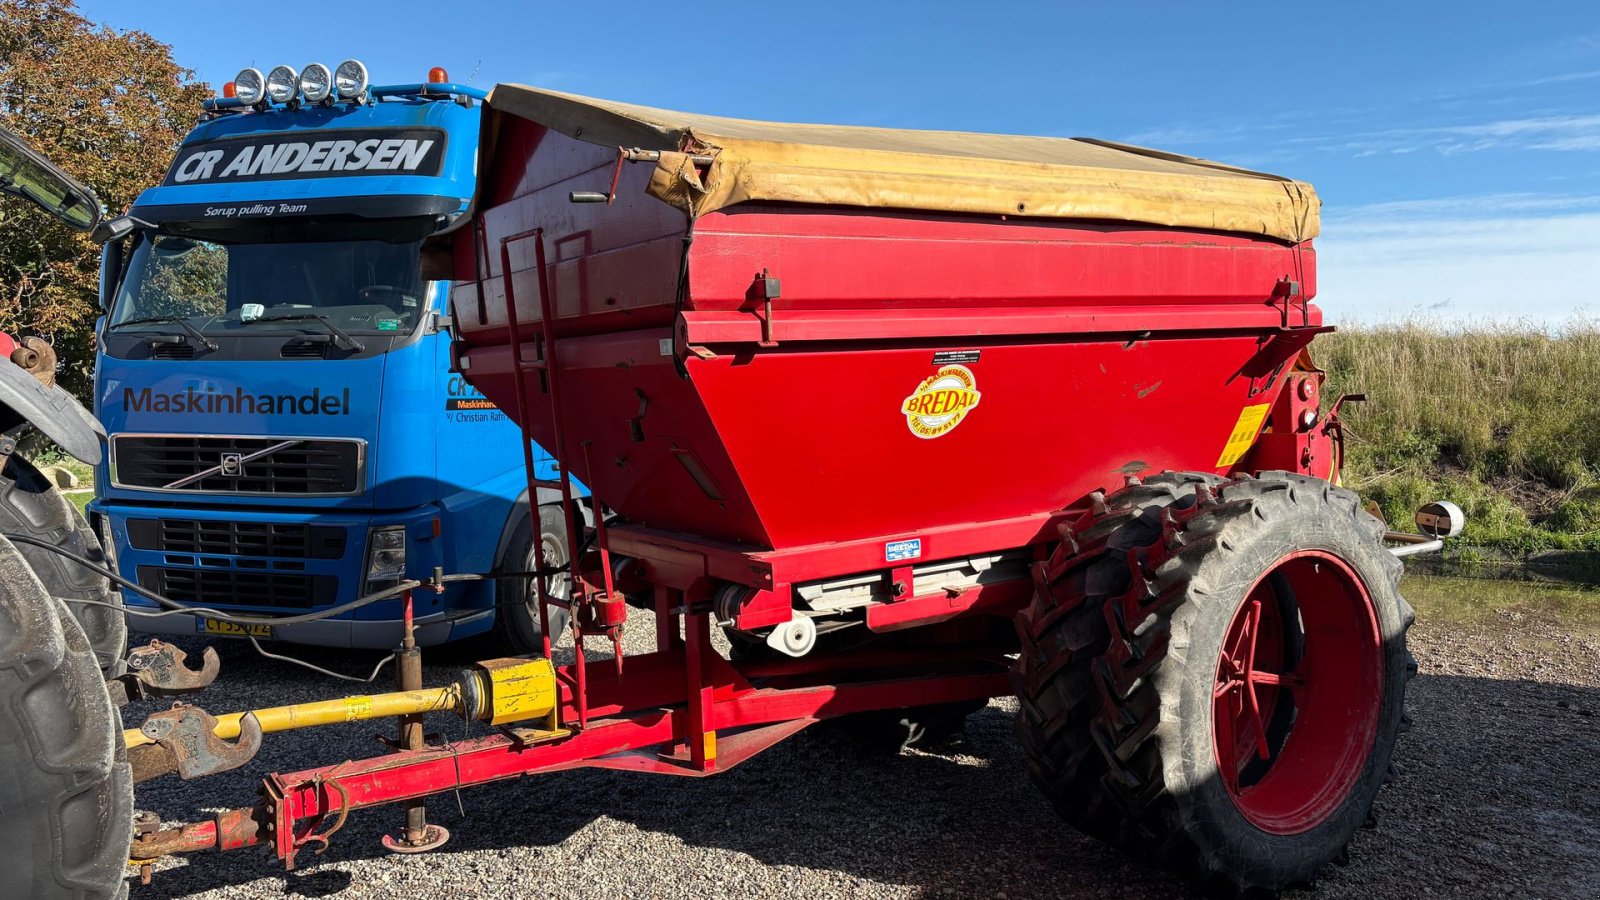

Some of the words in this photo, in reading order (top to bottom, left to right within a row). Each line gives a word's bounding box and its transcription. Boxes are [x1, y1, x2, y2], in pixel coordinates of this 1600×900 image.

[174, 149, 224, 183] CR
[218, 139, 434, 178] ANDERSEN
[204, 206, 236, 218] Sørup
[237, 203, 275, 217] pulling
[278, 203, 307, 213] Team
[123, 387, 350, 416] Maskinhandel
[907, 390, 975, 415] BREDAL
[456, 412, 488, 423] Christian
